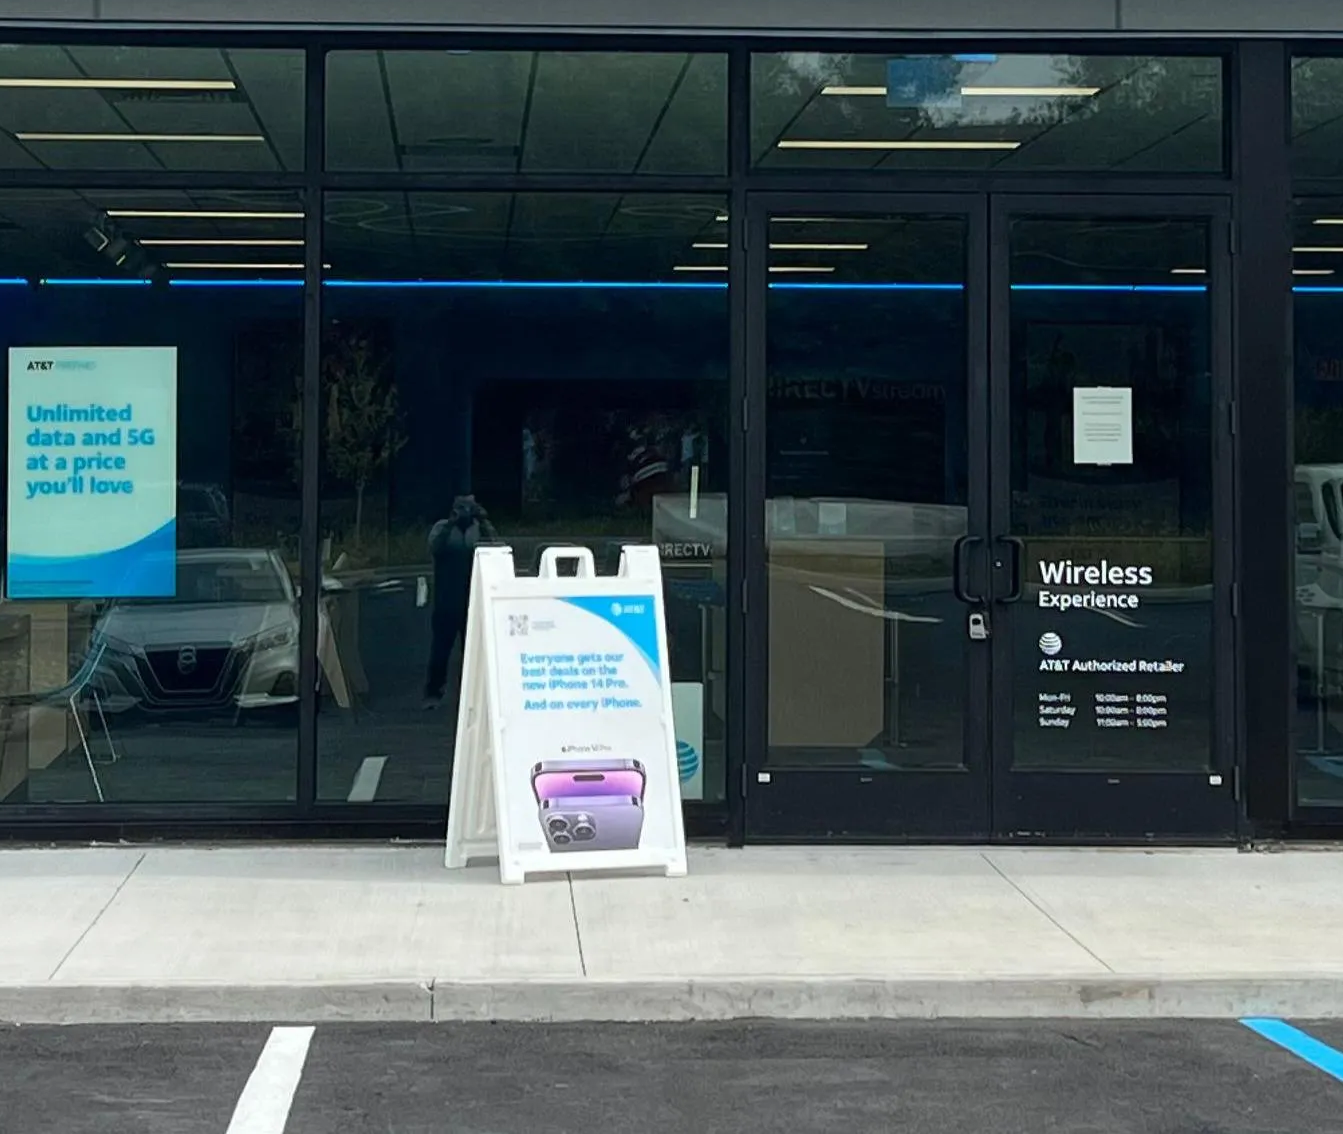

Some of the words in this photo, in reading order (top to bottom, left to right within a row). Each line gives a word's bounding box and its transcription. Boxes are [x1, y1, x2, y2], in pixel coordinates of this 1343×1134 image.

[27, 361, 54, 371] AT&T
[26, 404, 132, 422] Unlimited
[26, 429, 75, 447] data
[81, 429, 121, 447] and
[127, 428, 155, 446] 5G
[26, 454, 48, 471] at
[55, 457, 67, 471] a
[73, 452, 126, 475] price
[26, 476, 83, 499] you'll
[90, 476, 133, 494] love
[660, 543, 710, 557] IRECTV
[1039, 560, 1153, 585] Wireless
[1038, 590, 1139, 611] Experience
[520, 653, 574, 665] Everyone
[577, 653, 602, 665] gets
[605, 653, 624, 662] our
[521, 666, 546, 677] best
[550, 666, 580, 676] deals
[582, 667, 596, 675] on
[599, 664, 617, 675] the
[1039, 660, 1070, 671] AT&T
[1072, 660, 1137, 672] Authorized
[1139, 660, 1185, 673] Retailer
[522, 681, 546, 690] new
[549, 678, 588, 690] iPhone
[591, 679, 603, 689] 14
[1039, 693, 1071, 703] Mon-Fri
[524, 699, 546, 710] And
[550, 701, 564, 709] on
[567, 700, 598, 711] every
[1039, 706, 1076, 716] Saturday
[1039, 718, 1070, 728] Sunday
